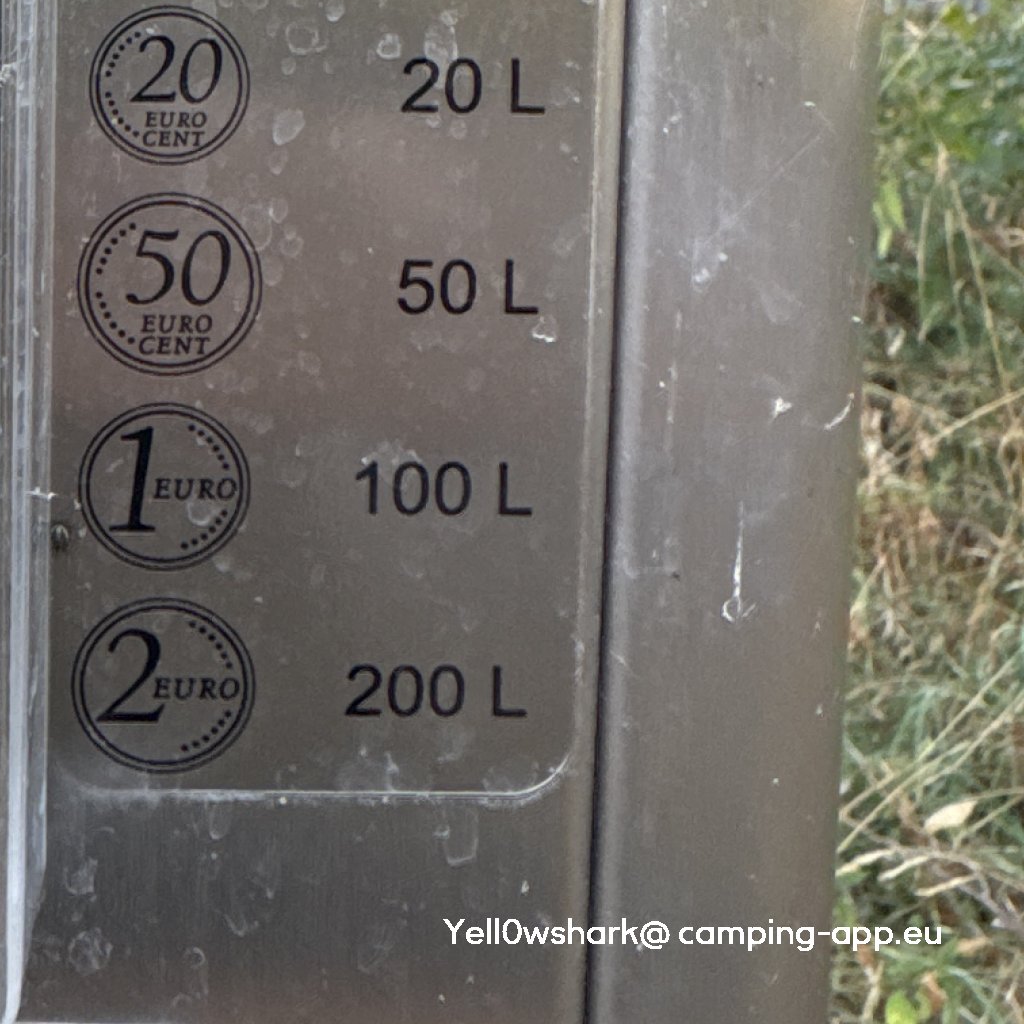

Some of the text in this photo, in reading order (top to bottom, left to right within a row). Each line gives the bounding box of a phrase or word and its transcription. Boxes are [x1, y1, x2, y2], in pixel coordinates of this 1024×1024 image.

[130, 34, 224, 104] 20
[400, 58, 545, 114] 20 L
[142, 129, 206, 148] CENT
[145, 110, 208, 129] EURO
[126, 229, 232, 306] 50
[397, 259, 538, 315] 50 L
[139, 336, 211, 356] CENT
[141, 314, 213, 335] EURO
[109, 426, 238, 533] 1 EURO
[355, 461, 532, 516] 100 L
[96, 628, 241, 723] 2 EURO
[344, 664, 527, 718] 200 L
